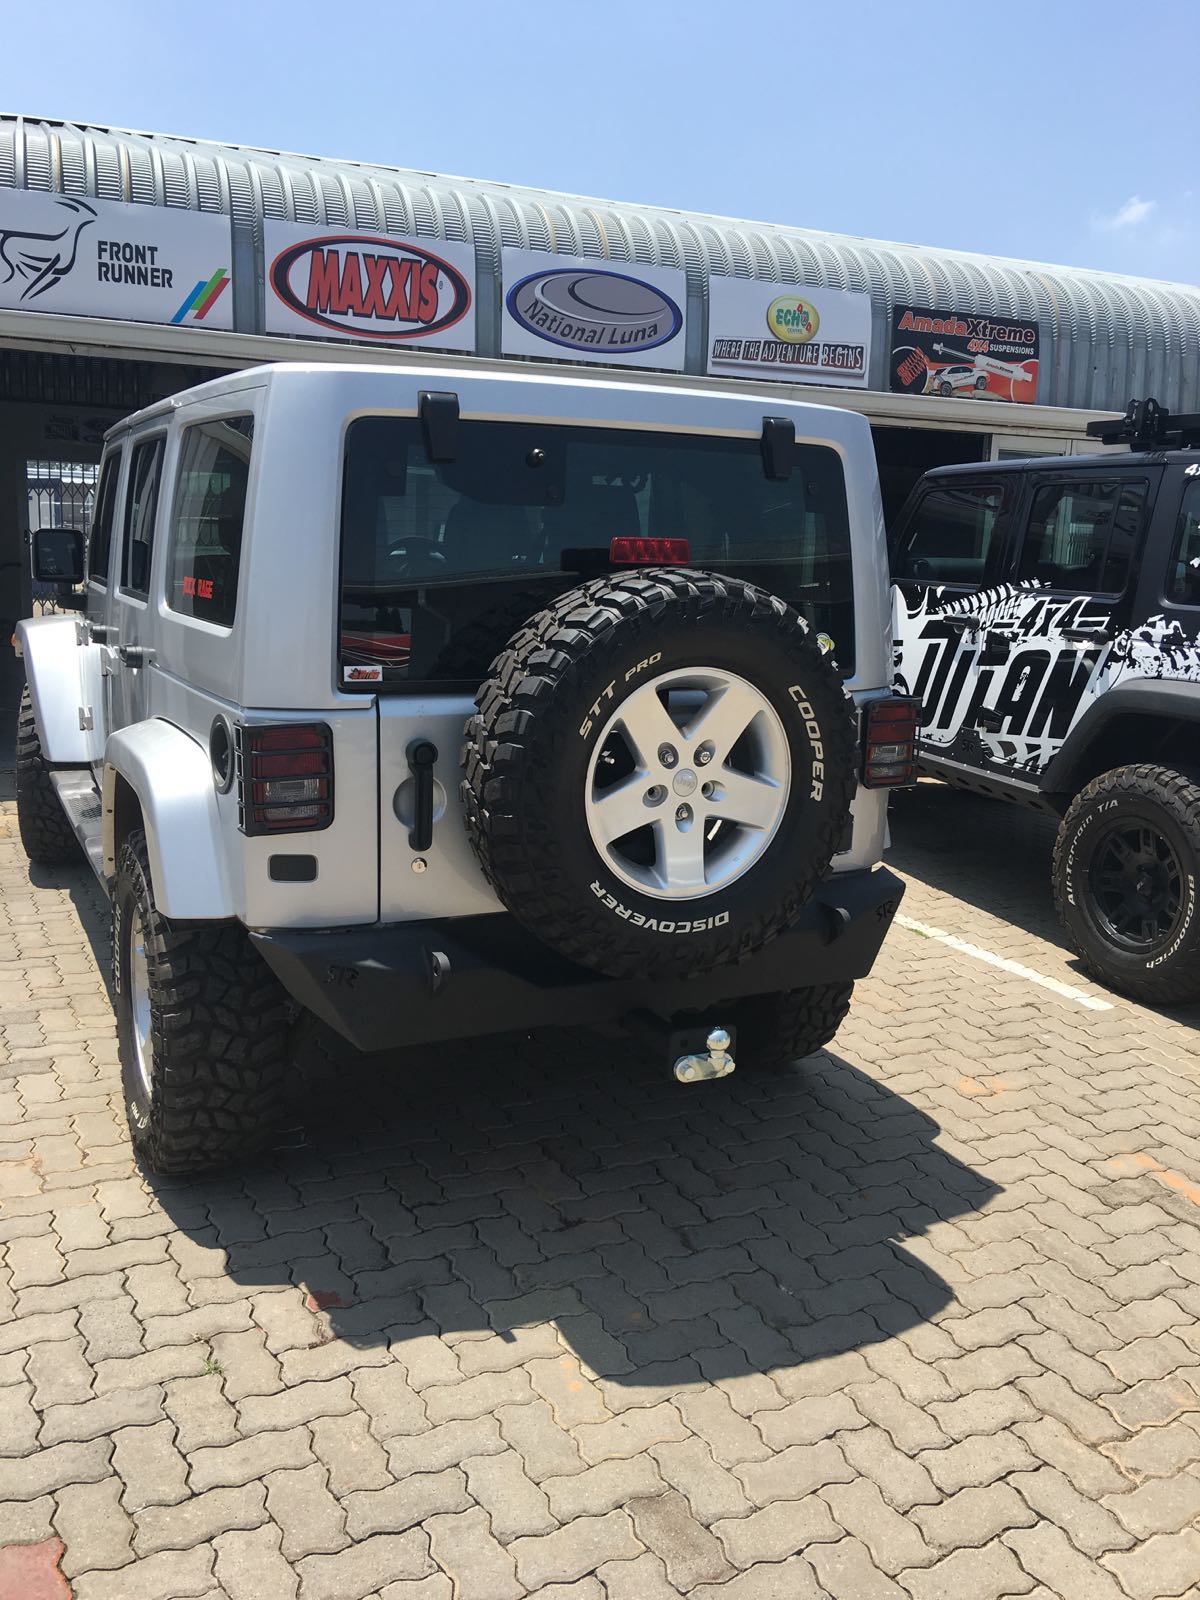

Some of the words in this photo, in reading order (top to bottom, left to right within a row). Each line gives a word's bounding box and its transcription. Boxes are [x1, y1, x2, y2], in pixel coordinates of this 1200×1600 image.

[98, 240, 158, 265] FRONT
[98, 262, 173, 288] RUNNER
[306, 248, 440, 325] MAXXIS
[523, 299, 606, 345] National
[607, 323, 659, 345] Luna
[898, 311, 1036, 344] AmadaXtreme
[714, 340, 741, 359] WHERE
[742, 341, 760, 360] THE
[762, 341, 819, 365] ADVENTURE
[822, 345, 863, 369] BEGINS
[989, 343, 1035, 356] SUSPENSIONS
[579, 680, 616, 740] STT
[624, 652, 662, 682] PRO
[787, 684, 825, 802] COOPER
[1065, 814, 1094, 906] All-Terrain
[1097, 799, 1119, 814] T/A
[589, 879, 730, 934] DISCOVERER
[1146, 874, 1195, 970] BFGoodrich
